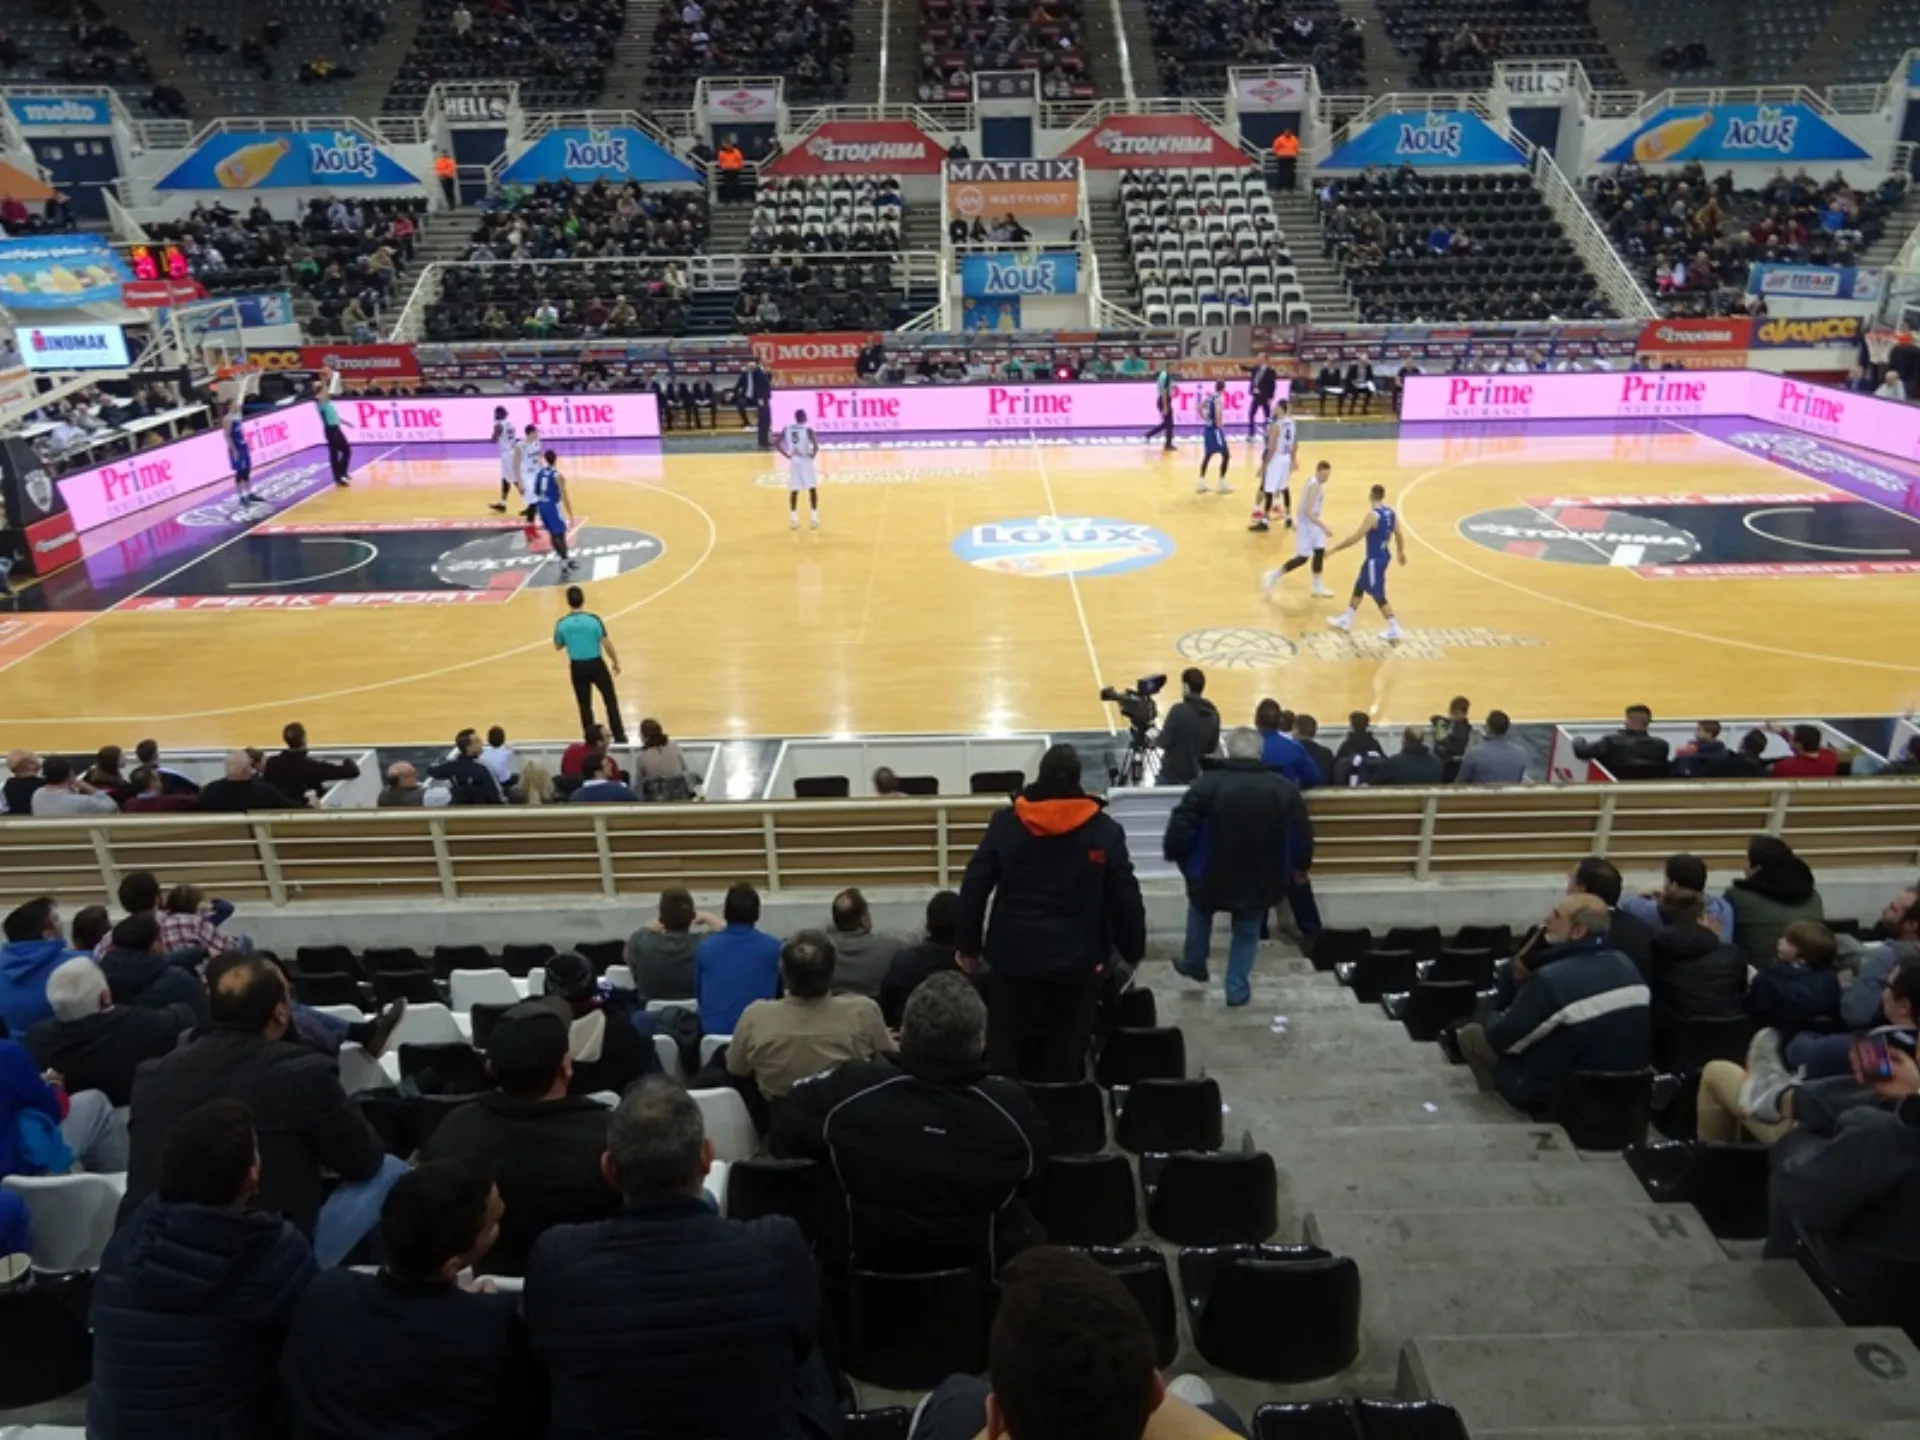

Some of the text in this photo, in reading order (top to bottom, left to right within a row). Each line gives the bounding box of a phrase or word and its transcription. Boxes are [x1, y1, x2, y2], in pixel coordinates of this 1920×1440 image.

[950, 160, 1074, 181] MATRIX
[988, 387, 1073, 415] Prime
[1449, 377, 1534, 406] Prime
[1622, 375, 1707, 404] Prime
[1777, 380, 1845, 423] Prime
[356, 402, 443, 429] Prime
[529, 396, 614, 424] Prime
[815, 390, 900, 418] Prime
[99, 458, 173, 502] Prime
